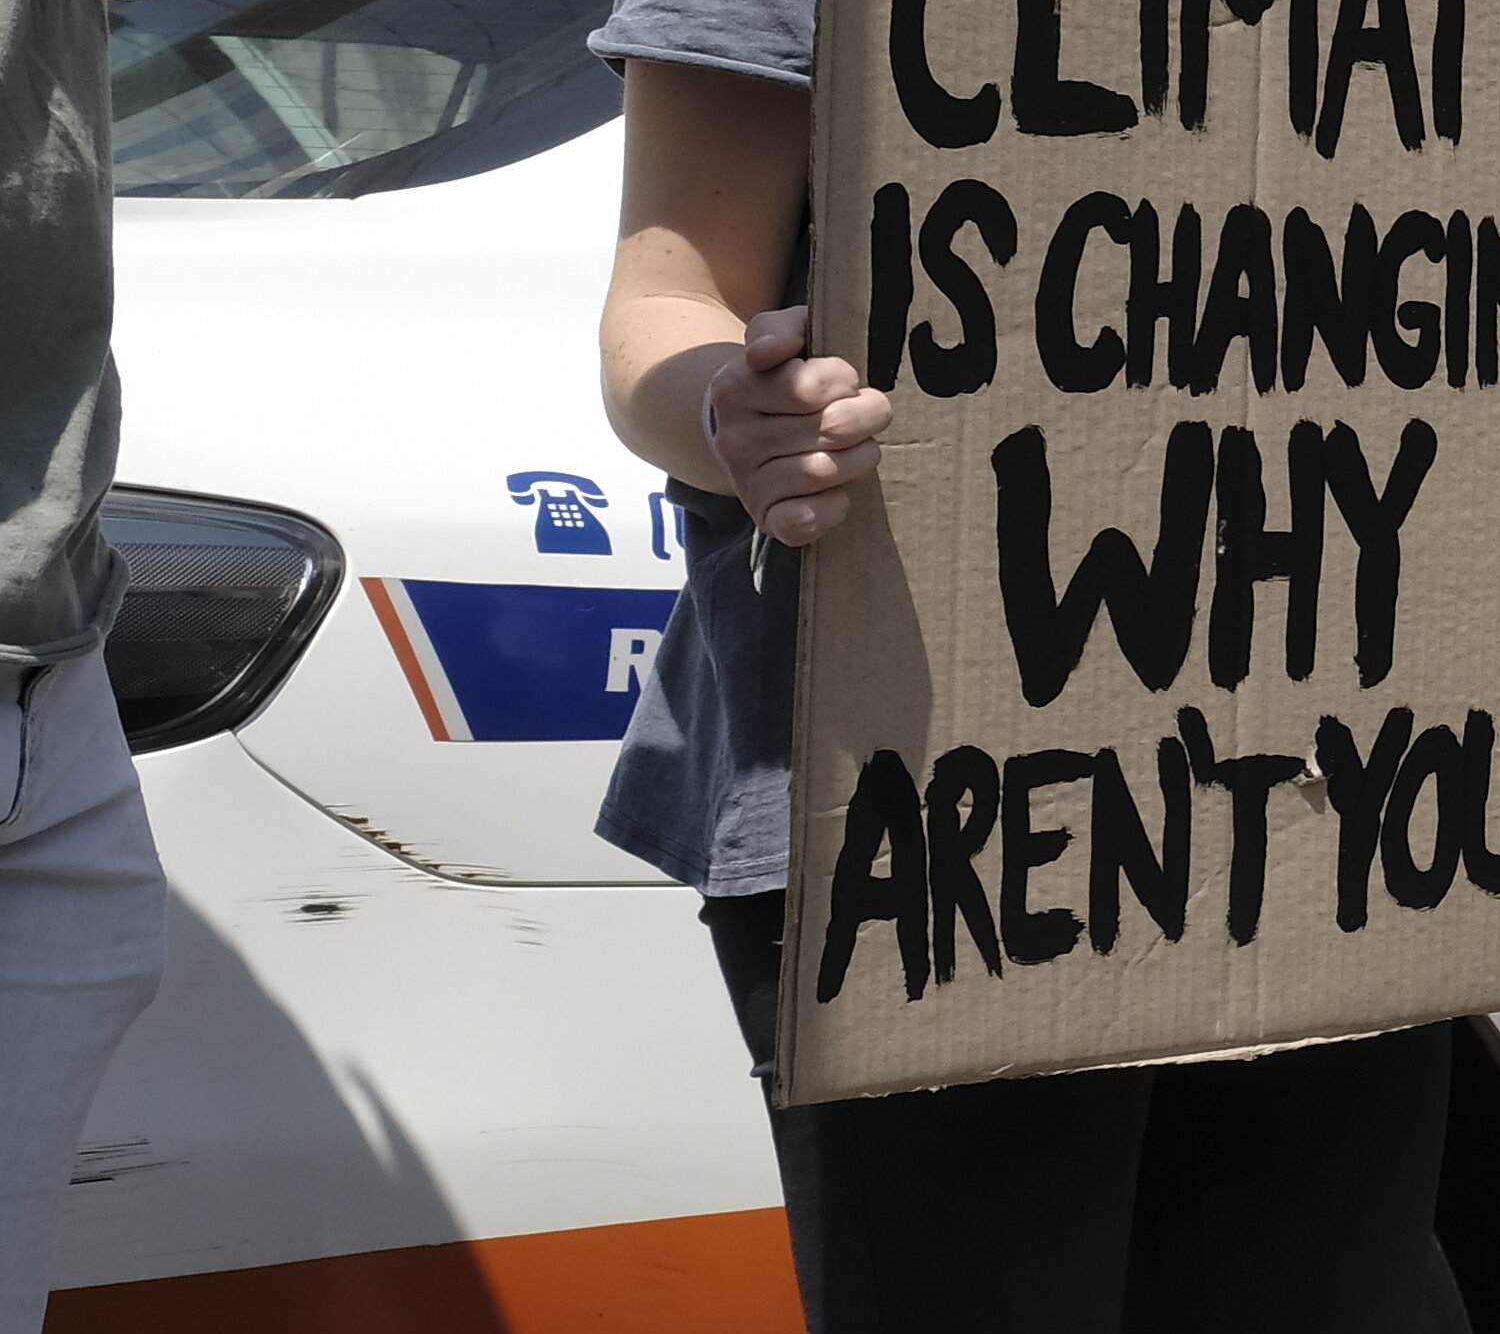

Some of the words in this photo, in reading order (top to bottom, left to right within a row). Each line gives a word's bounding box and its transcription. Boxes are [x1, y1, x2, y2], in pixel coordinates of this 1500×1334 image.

[866, 178, 1019, 398] IS
[990, 419, 1438, 707] WHY
[817, 705, 1314, 1004] AREN'T
